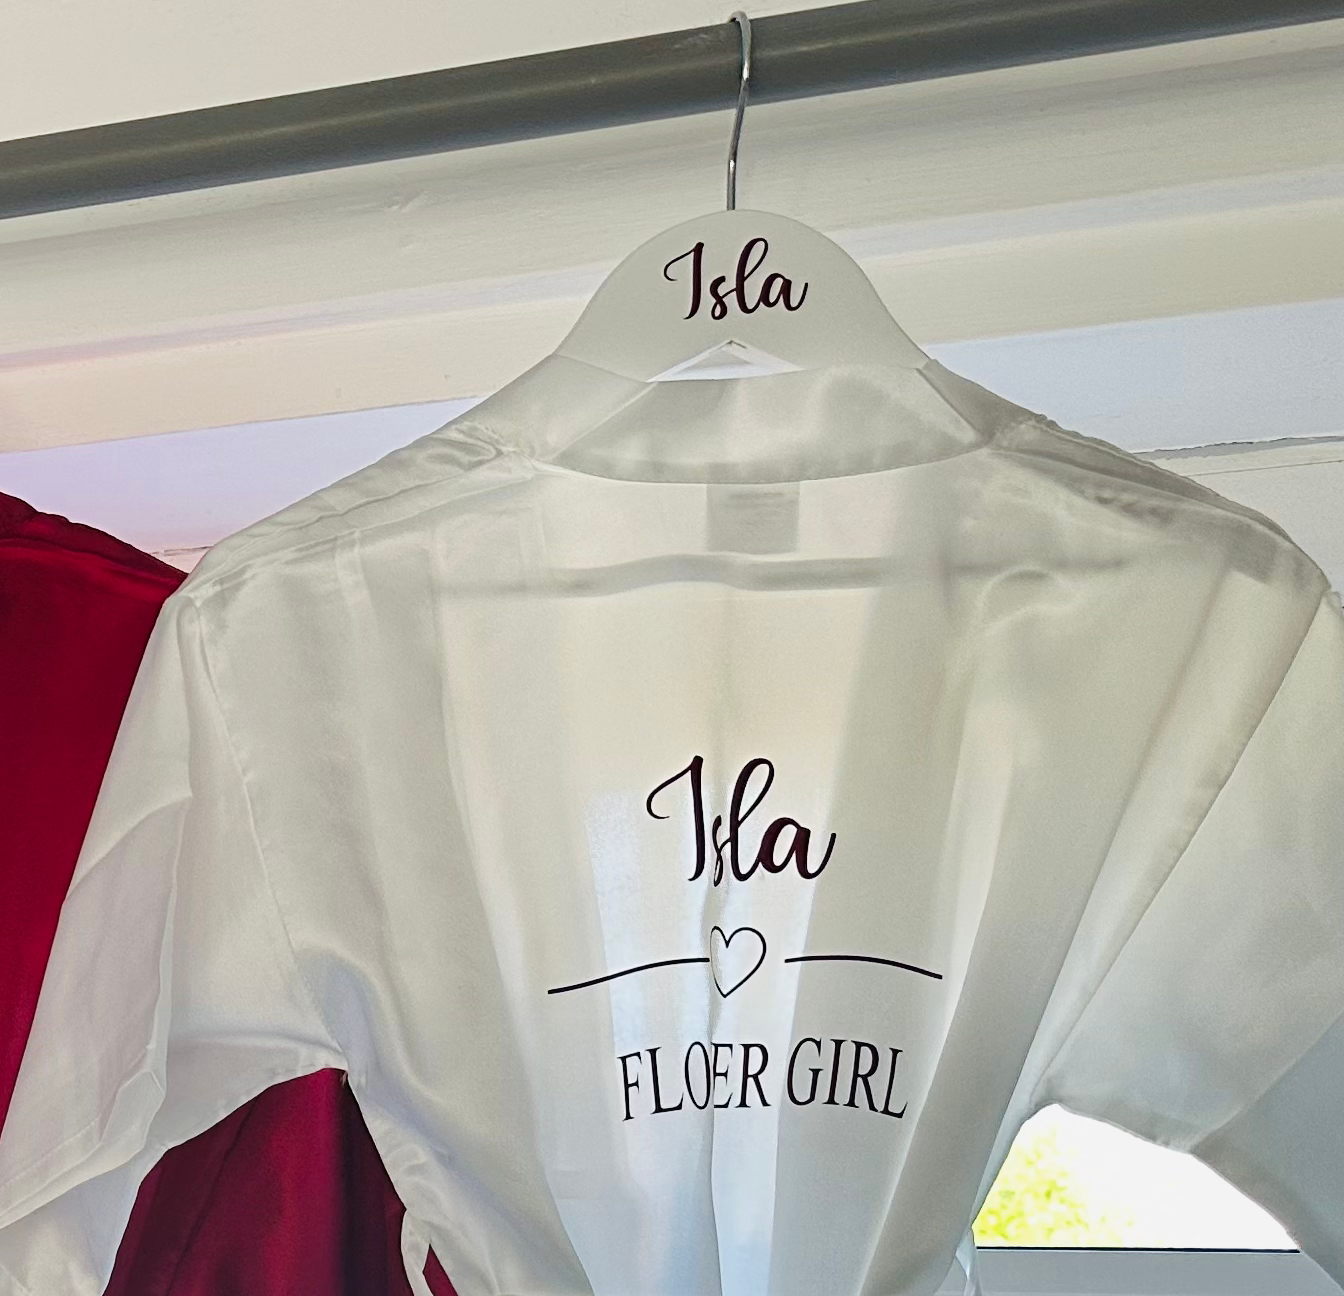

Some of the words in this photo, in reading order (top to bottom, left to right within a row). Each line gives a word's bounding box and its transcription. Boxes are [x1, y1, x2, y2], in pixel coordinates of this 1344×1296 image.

[664, 237, 808, 320] Isla
[646, 755, 836, 887] Isla
[617, 1041, 771, 1122] FLOER
[787, 1037, 908, 1119] GIRL
